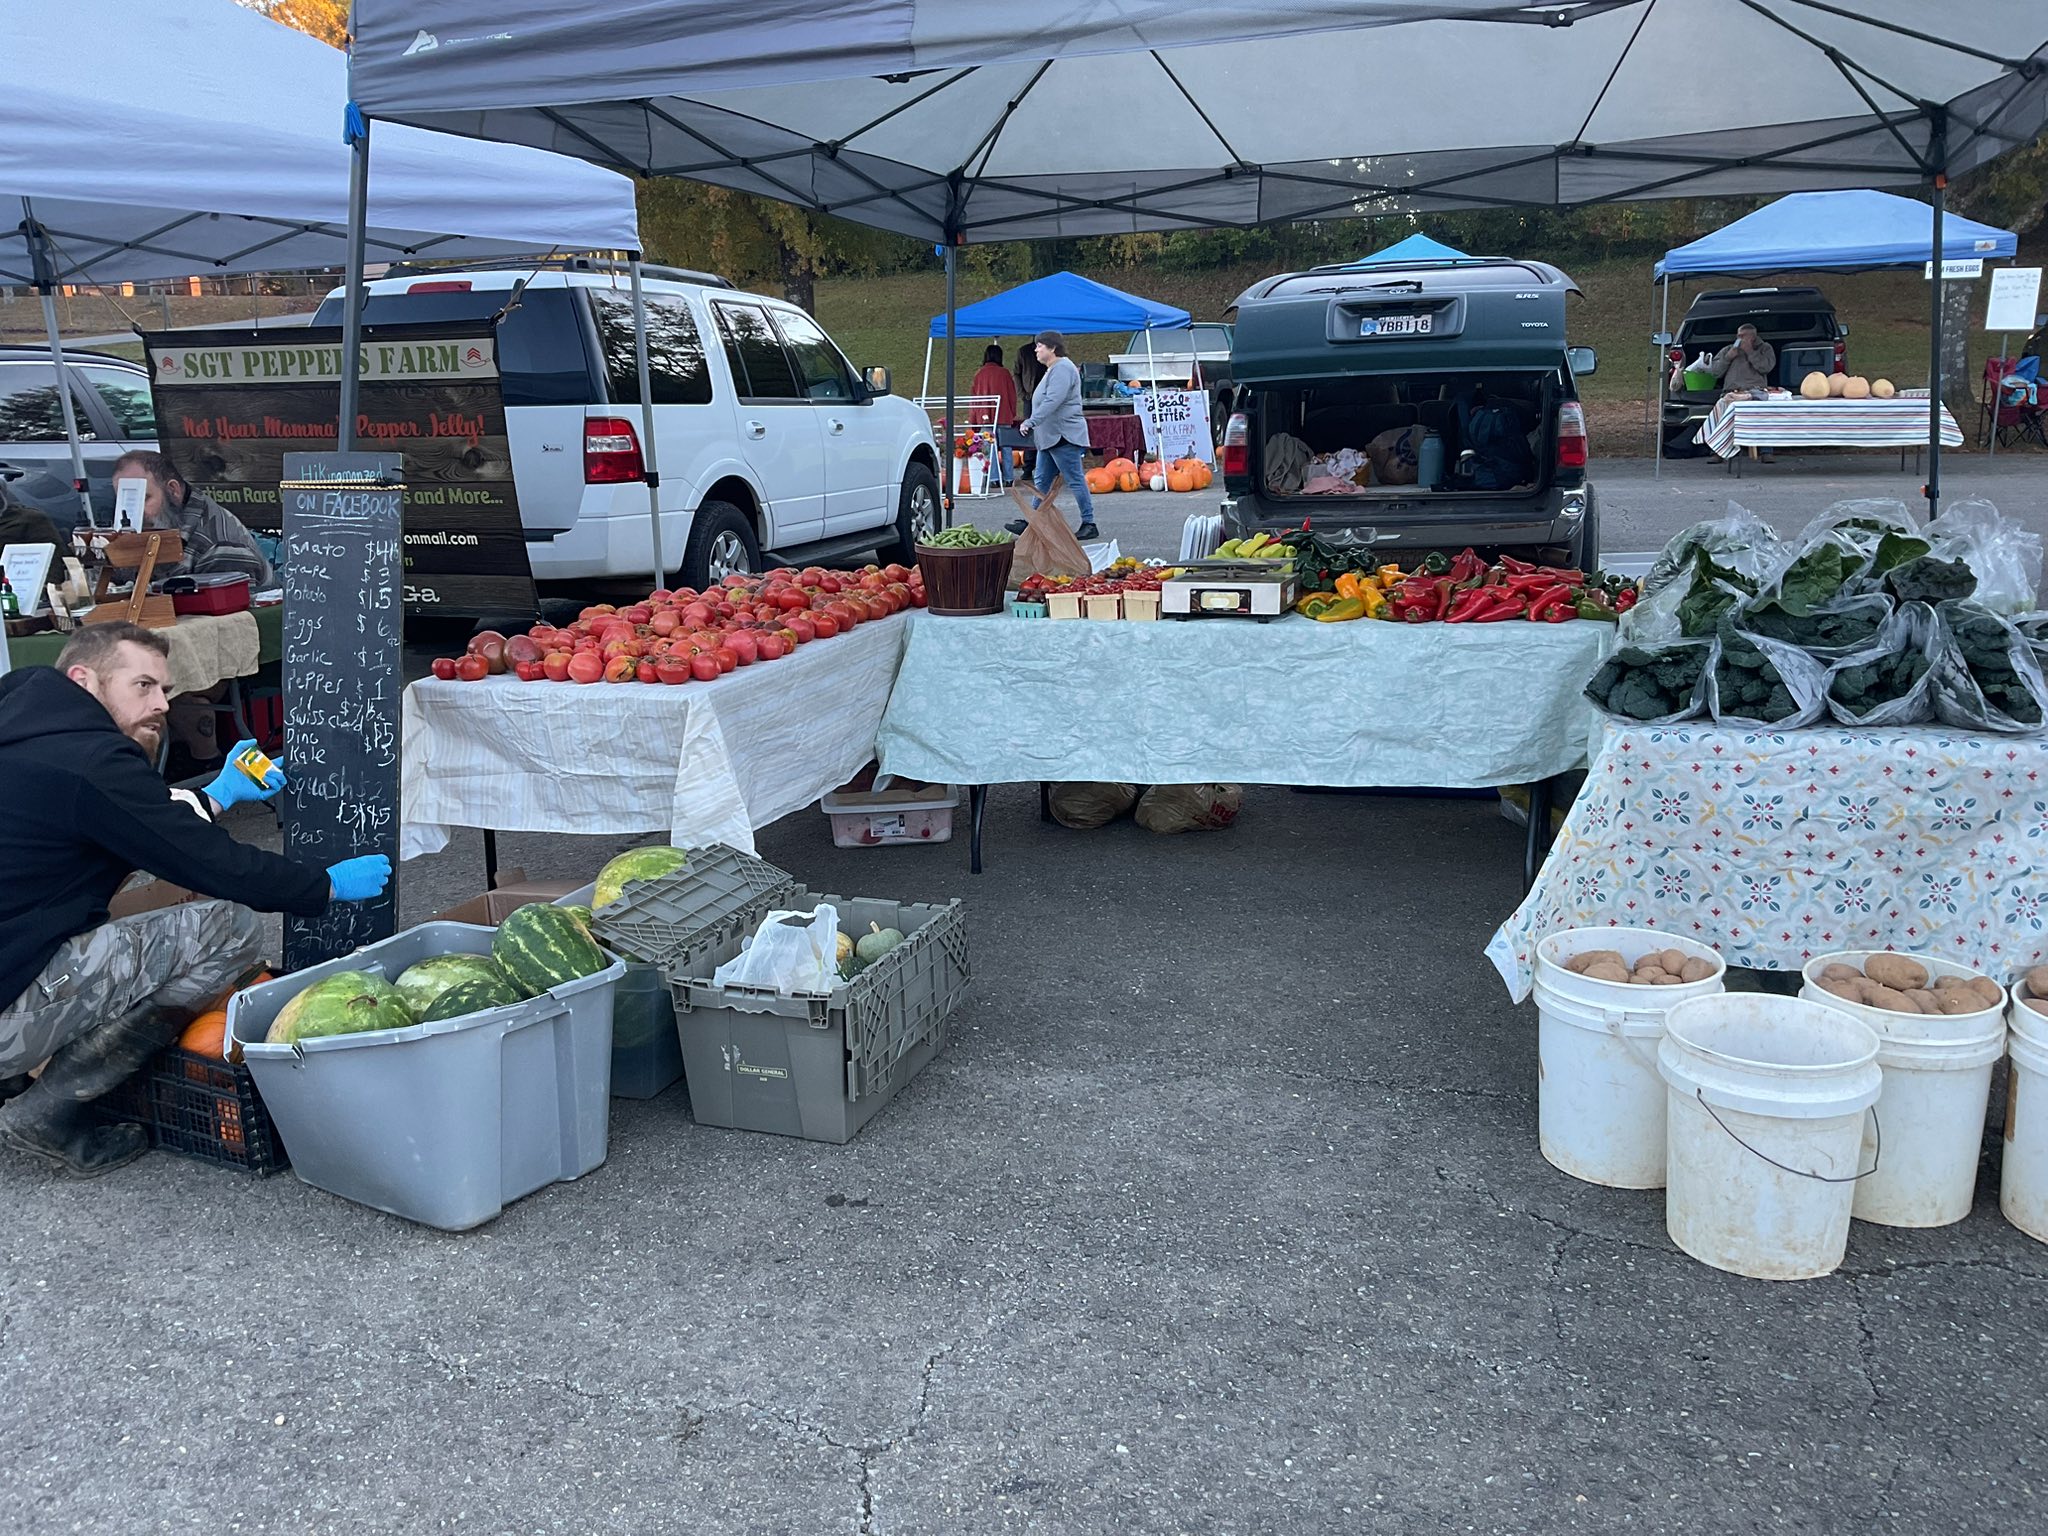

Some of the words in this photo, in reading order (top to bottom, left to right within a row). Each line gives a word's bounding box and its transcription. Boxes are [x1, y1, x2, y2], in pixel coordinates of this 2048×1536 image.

[1965, 264, 1980, 272] EGGS
[183, 350, 233, 379] SGT
[378, 345, 461, 374] FARM
[182, 415, 214, 438] Not
[215, 415, 261, 446] Your
[263, 414, 341, 439] Momma'
[355, 414, 421, 445] Pepper
[424, 411, 486, 449] Jelly!
[242, 487, 276, 503] Rare
[296, 493, 316, 511] ON
[322, 490, 400, 519] FACEBOOK
[414, 487, 445, 504] and
[448, 488, 504, 504] More...
[286, 644, 333, 665] Garlic
[290, 744, 326, 765] Kale
